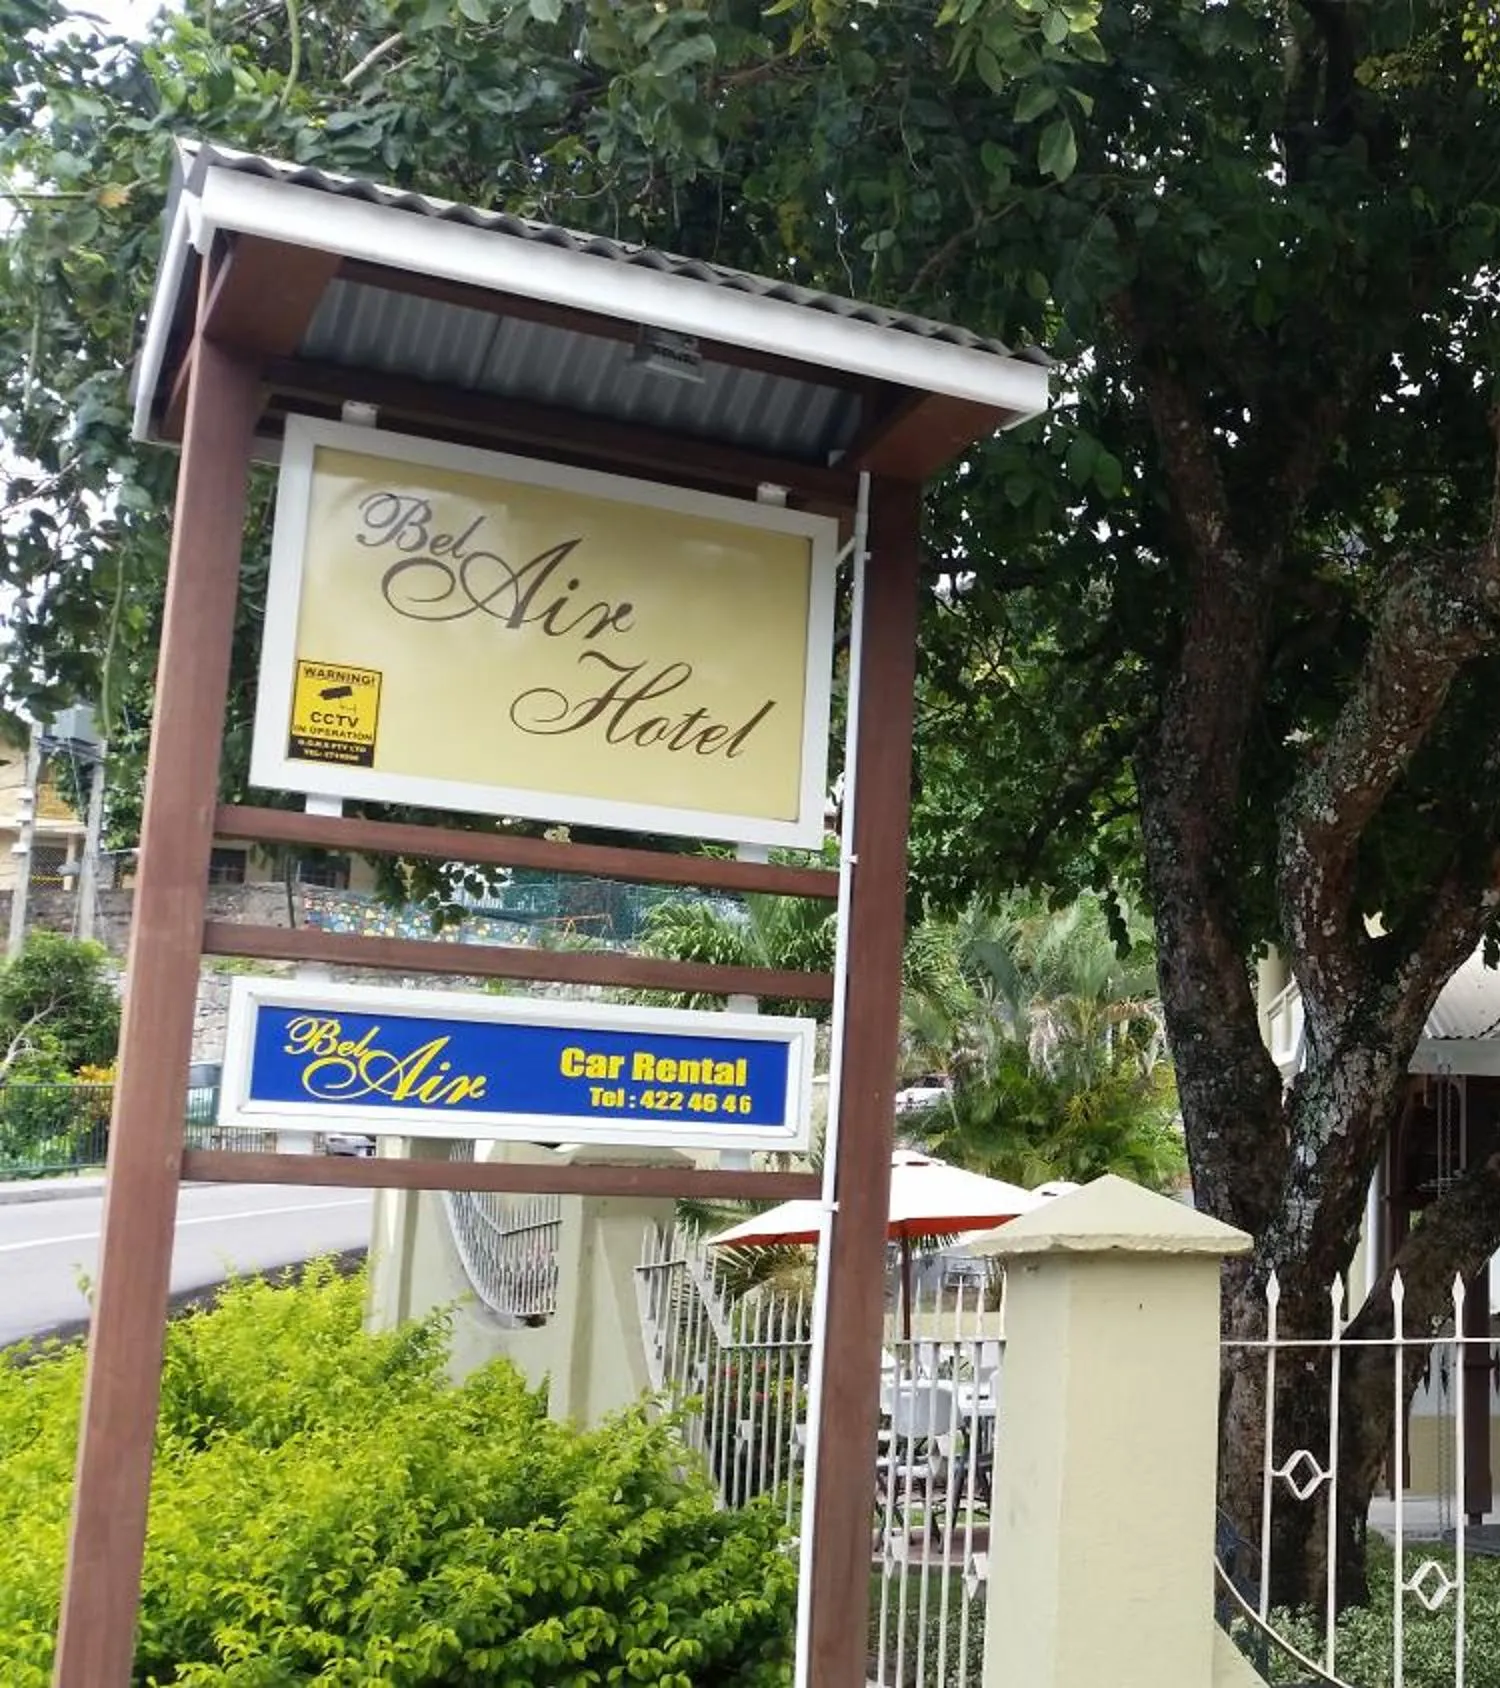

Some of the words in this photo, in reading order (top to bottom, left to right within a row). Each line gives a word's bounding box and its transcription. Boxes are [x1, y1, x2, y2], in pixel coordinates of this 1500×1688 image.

[355, 492, 487, 558] Bel
[381, 537, 637, 642] Air
[303, 667, 376, 686] WARNING!
[310, 711, 359, 728] CCTV
[509, 650, 776, 760] Hotel
[310, 727, 372, 740] OPERATION
[284, 1015, 381, 1058] Bel
[302, 1035, 487, 1105] Air
[560, 1046, 626, 1079] Car
[631, 1051, 748, 1088] Rental
[639, 1088, 684, 1112] 422
[687, 1092, 718, 1114] 46
[721, 1093, 753, 1115] 46
